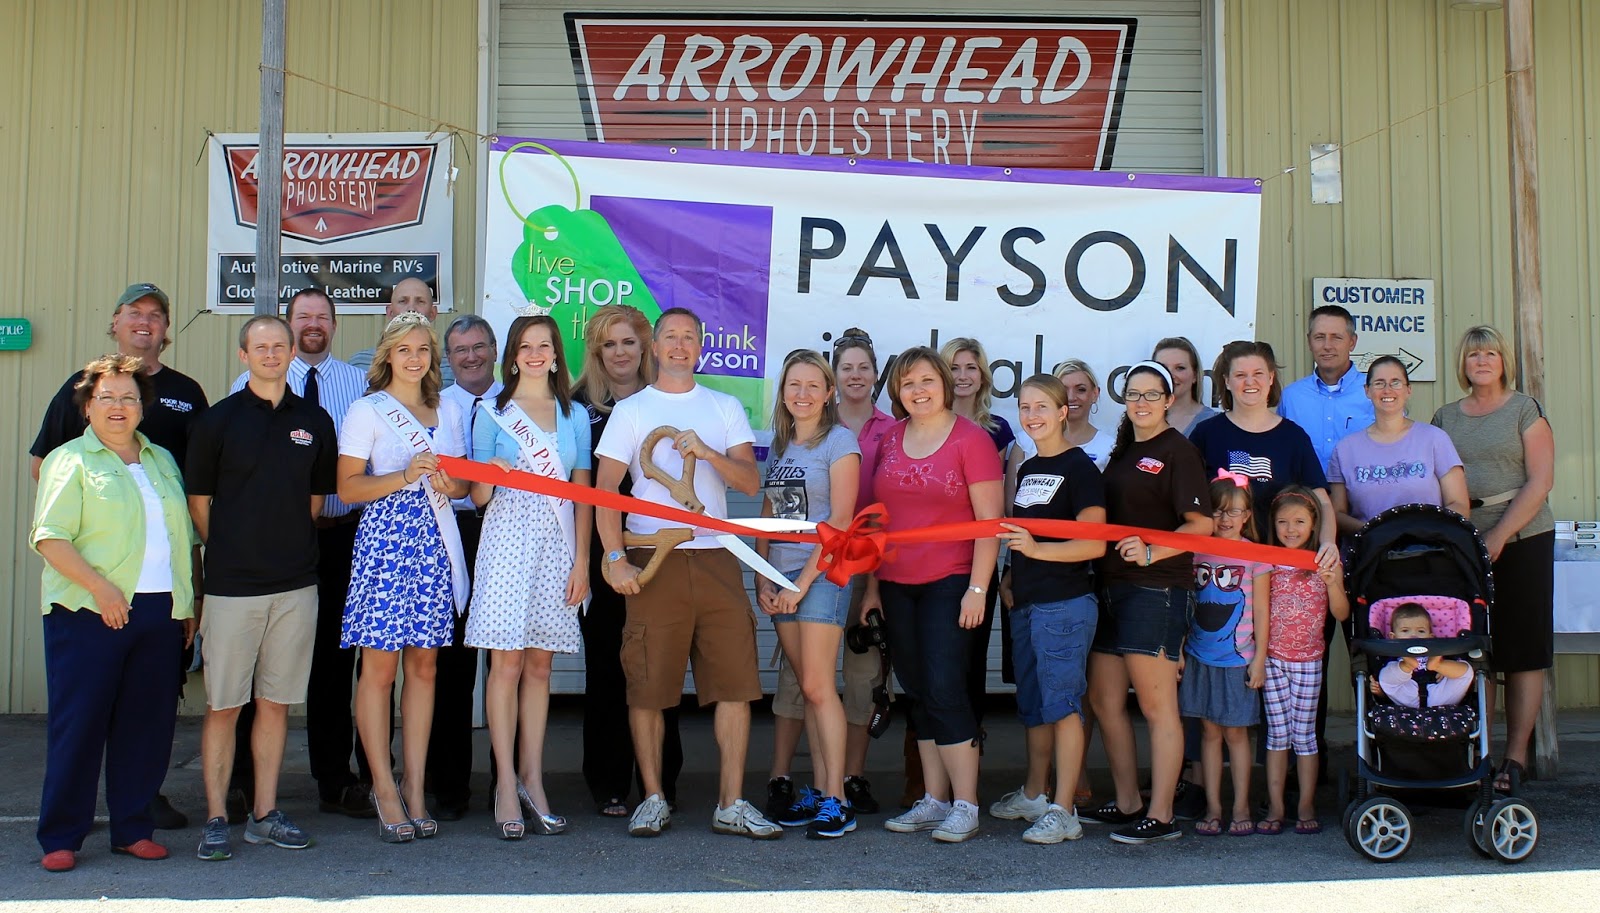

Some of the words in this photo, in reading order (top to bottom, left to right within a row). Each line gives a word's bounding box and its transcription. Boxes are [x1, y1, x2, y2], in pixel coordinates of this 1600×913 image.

[613, 33, 1092, 104] ARROWHEAD
[240, 151, 421, 180] AROWHEAD
[284, 180, 377, 215] PHOLSTERY
[230, 259, 319, 274] Autotive
[329, 259, 382, 274] Marine
[392, 258, 424, 274] RV's
[528, 244, 576, 276] live
[797, 216, 1237, 319] PAYSON
[225, 284, 256, 299] Clot
[325, 284, 382, 299] Leather
[545, 276, 634, 307] SHOP
[1322, 285, 1425, 305] CUSTOMER
[701, 322, 757, 351] hink
[1352, 314, 1425, 333] TRANCE
[696, 351, 758, 372] yson
